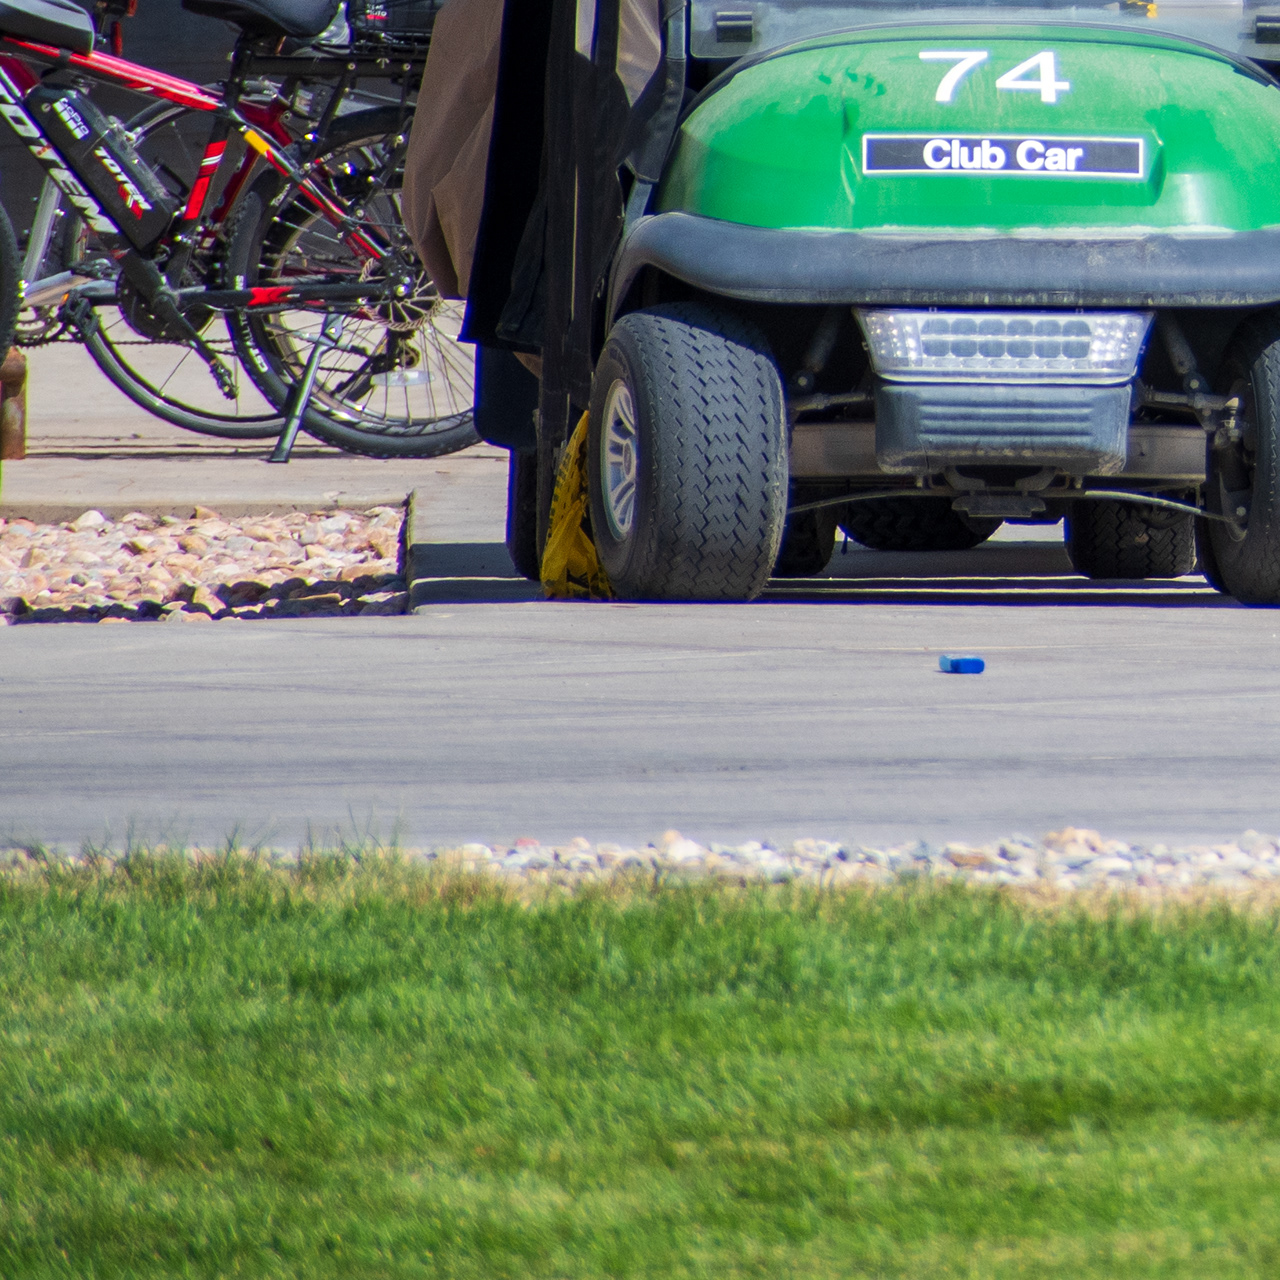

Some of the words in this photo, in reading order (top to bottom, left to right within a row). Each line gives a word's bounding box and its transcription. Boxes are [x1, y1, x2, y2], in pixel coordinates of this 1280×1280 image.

[918, 50, 1070, 103] 74
[93, 145, 154, 210] TOTEM
[922, 139, 1006, 171] Club
[1015, 141, 1084, 172] Car
